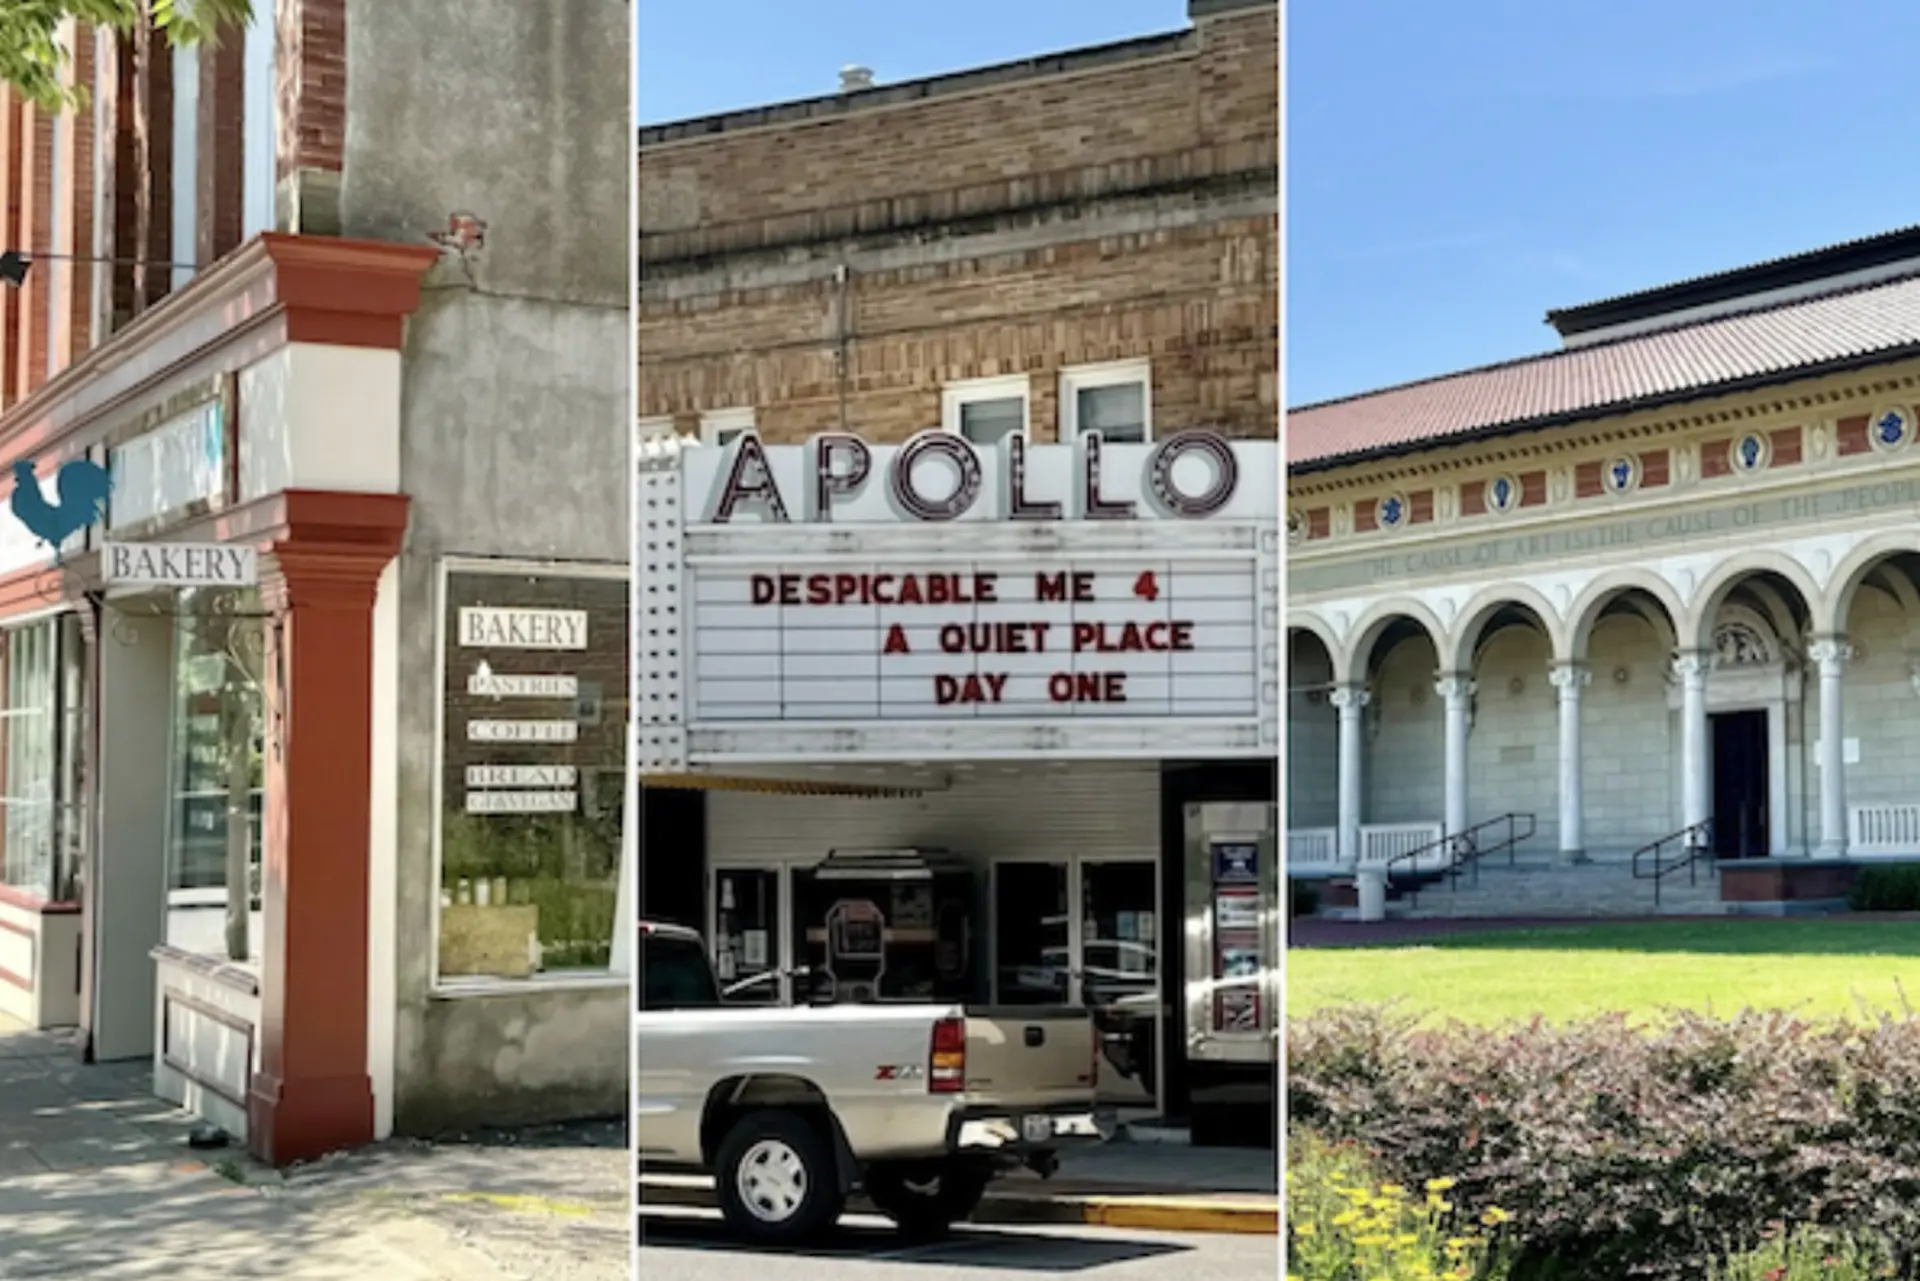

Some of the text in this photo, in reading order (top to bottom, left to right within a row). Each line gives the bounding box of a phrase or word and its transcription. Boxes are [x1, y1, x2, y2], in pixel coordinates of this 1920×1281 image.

[711, 430, 1240, 524] APOLLO
[1646, 510, 1714, 539] CAUSE
[1732, 503, 1762, 528] OF
[111, 546, 249, 580] BAKERY
[751, 570, 1160, 605] DESPICABLE ME 4
[467, 612, 583, 644] BAKERY
[883, 620, 1195, 654] A QUIET PLACE
[934, 671, 1128, 705] DAY ONE
[468, 768, 577, 783] BREAD
